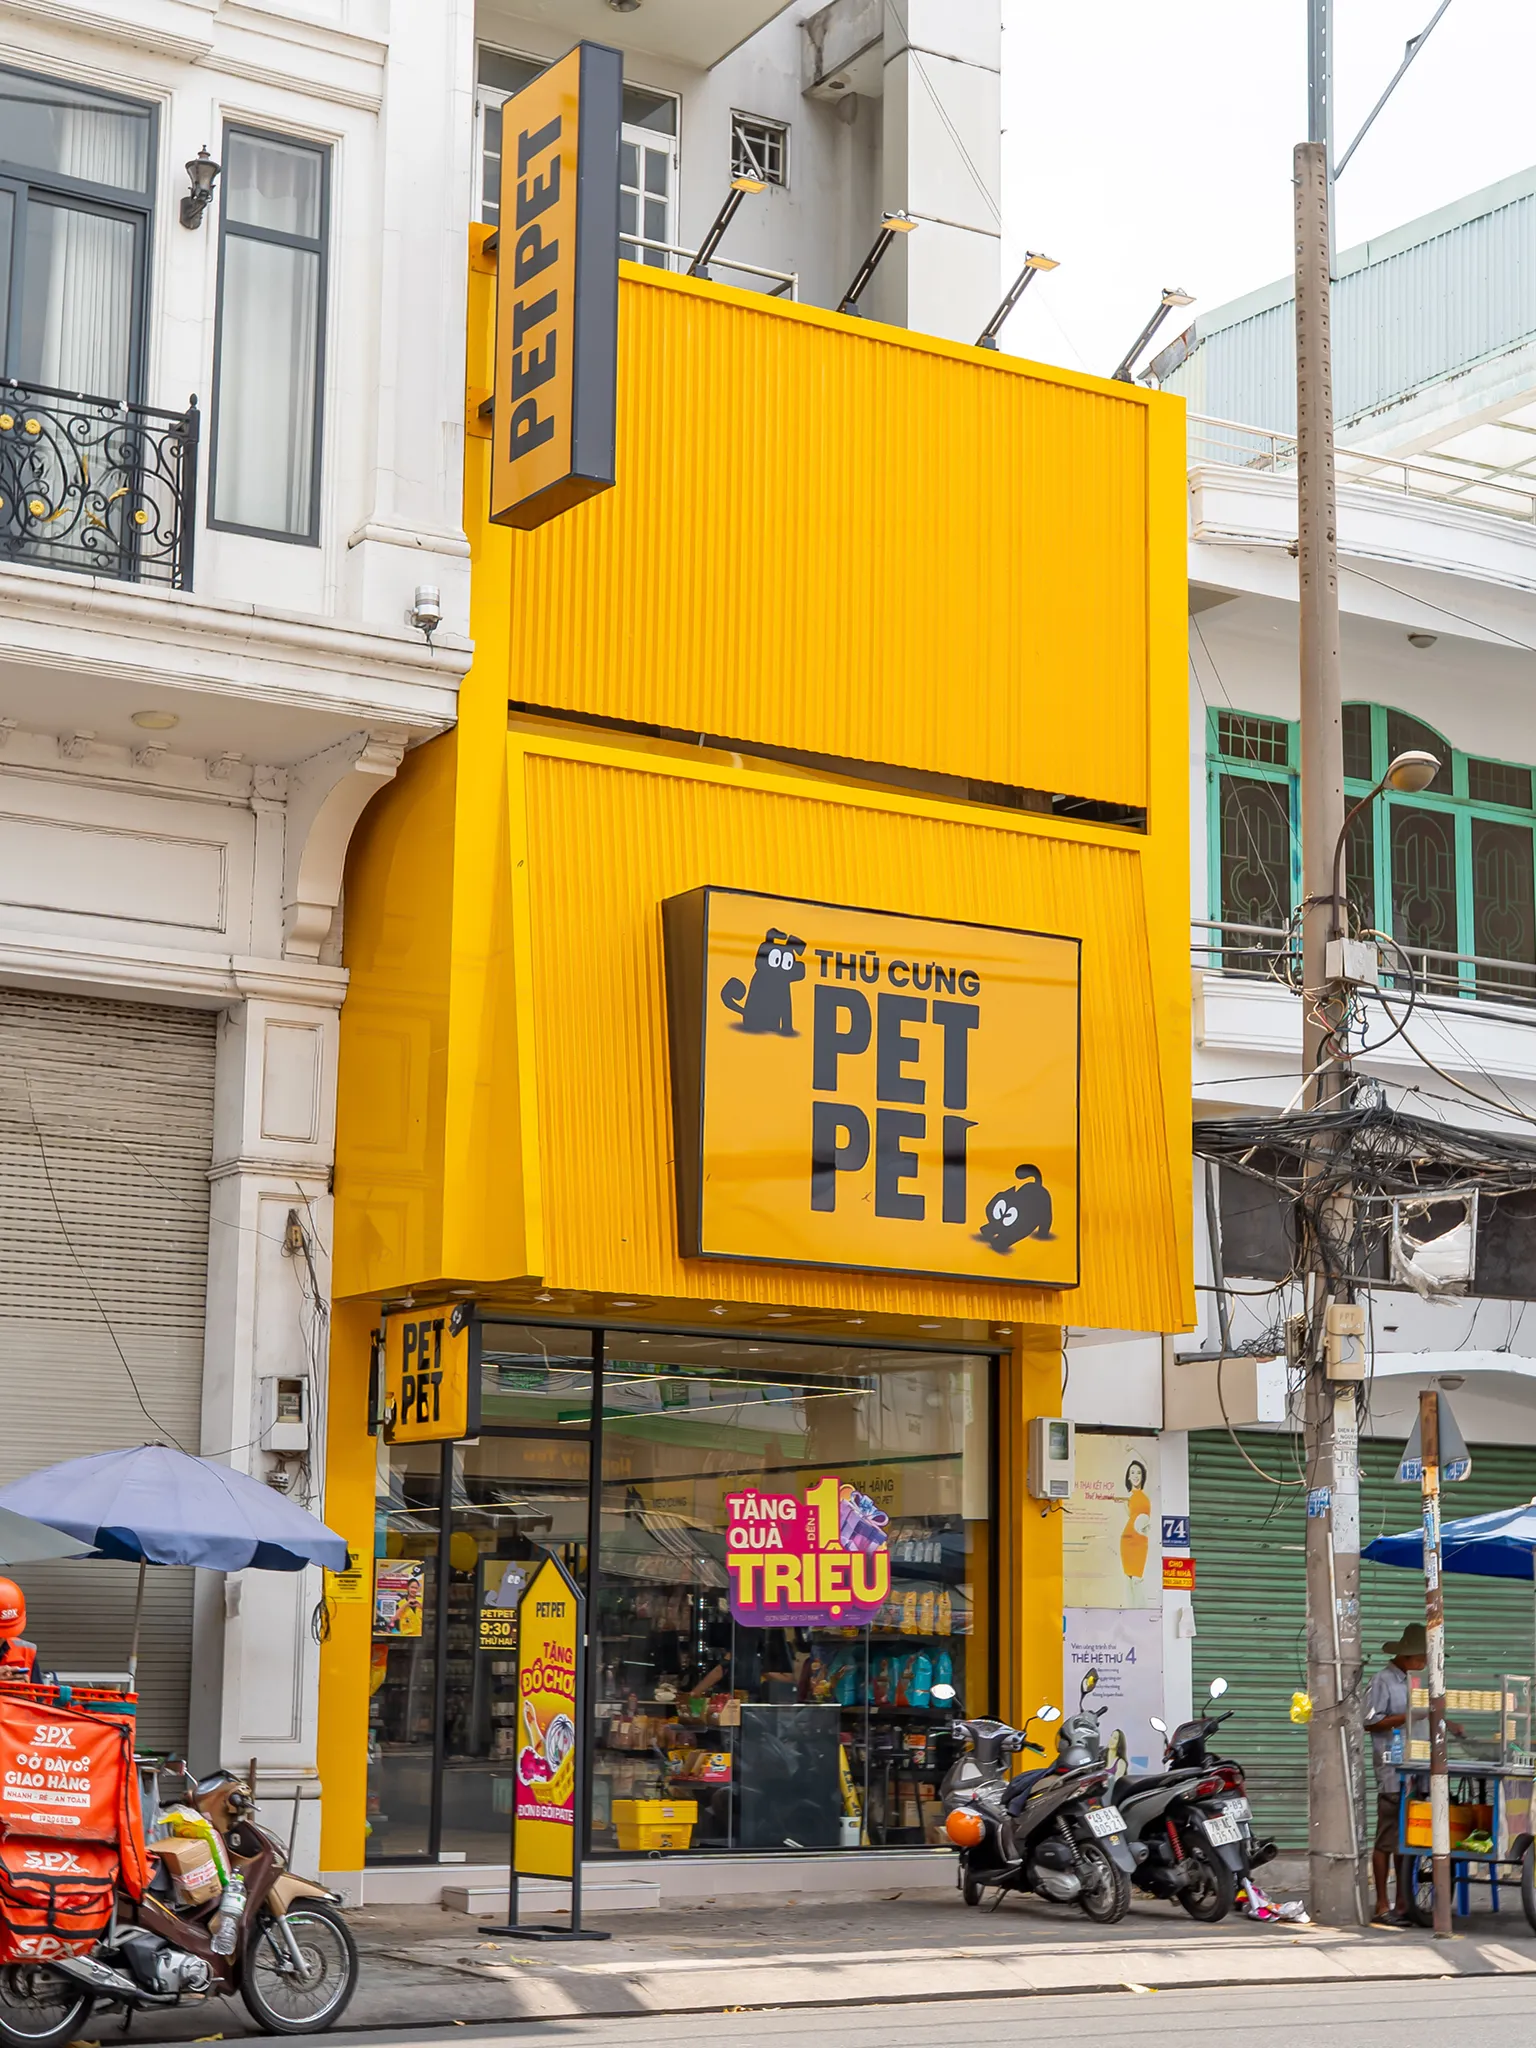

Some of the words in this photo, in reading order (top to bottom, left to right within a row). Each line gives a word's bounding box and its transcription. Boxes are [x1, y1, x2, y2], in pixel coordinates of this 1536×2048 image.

[514, 114, 562, 290] PET
[509, 289, 558, 463] PET
[812, 983, 980, 1111] PET
[402, 1318, 445, 1373] PET
[401, 1371, 443, 1425] PET
[729, 1493, 797, 1525] TẶNG
[806, 1478, 830, 1549] 1
[729, 1522, 783, 1549] QUÀ
[1163, 1520, 1186, 1538] 74
[728, 1541, 889, 1615] TRIỆU
[536, 1602, 550, 1618] PET
[551, 1602, 565, 1618] PET
[480, 1622, 510, 1636] 9:30
[544, 1640, 572, 1664] TẶNG
[1126, 1646, 1137, 1664] 4
[32, 1725, 74, 1748] SPX
[5, 1770, 44, 1787] GIAO
[47, 1773, 91, 1792] HÀNG
[6, 1790, 32, 1800] NHANH
[24, 1850, 80, 1872] SPX
[18, 1936, 84, 1958] SPX
